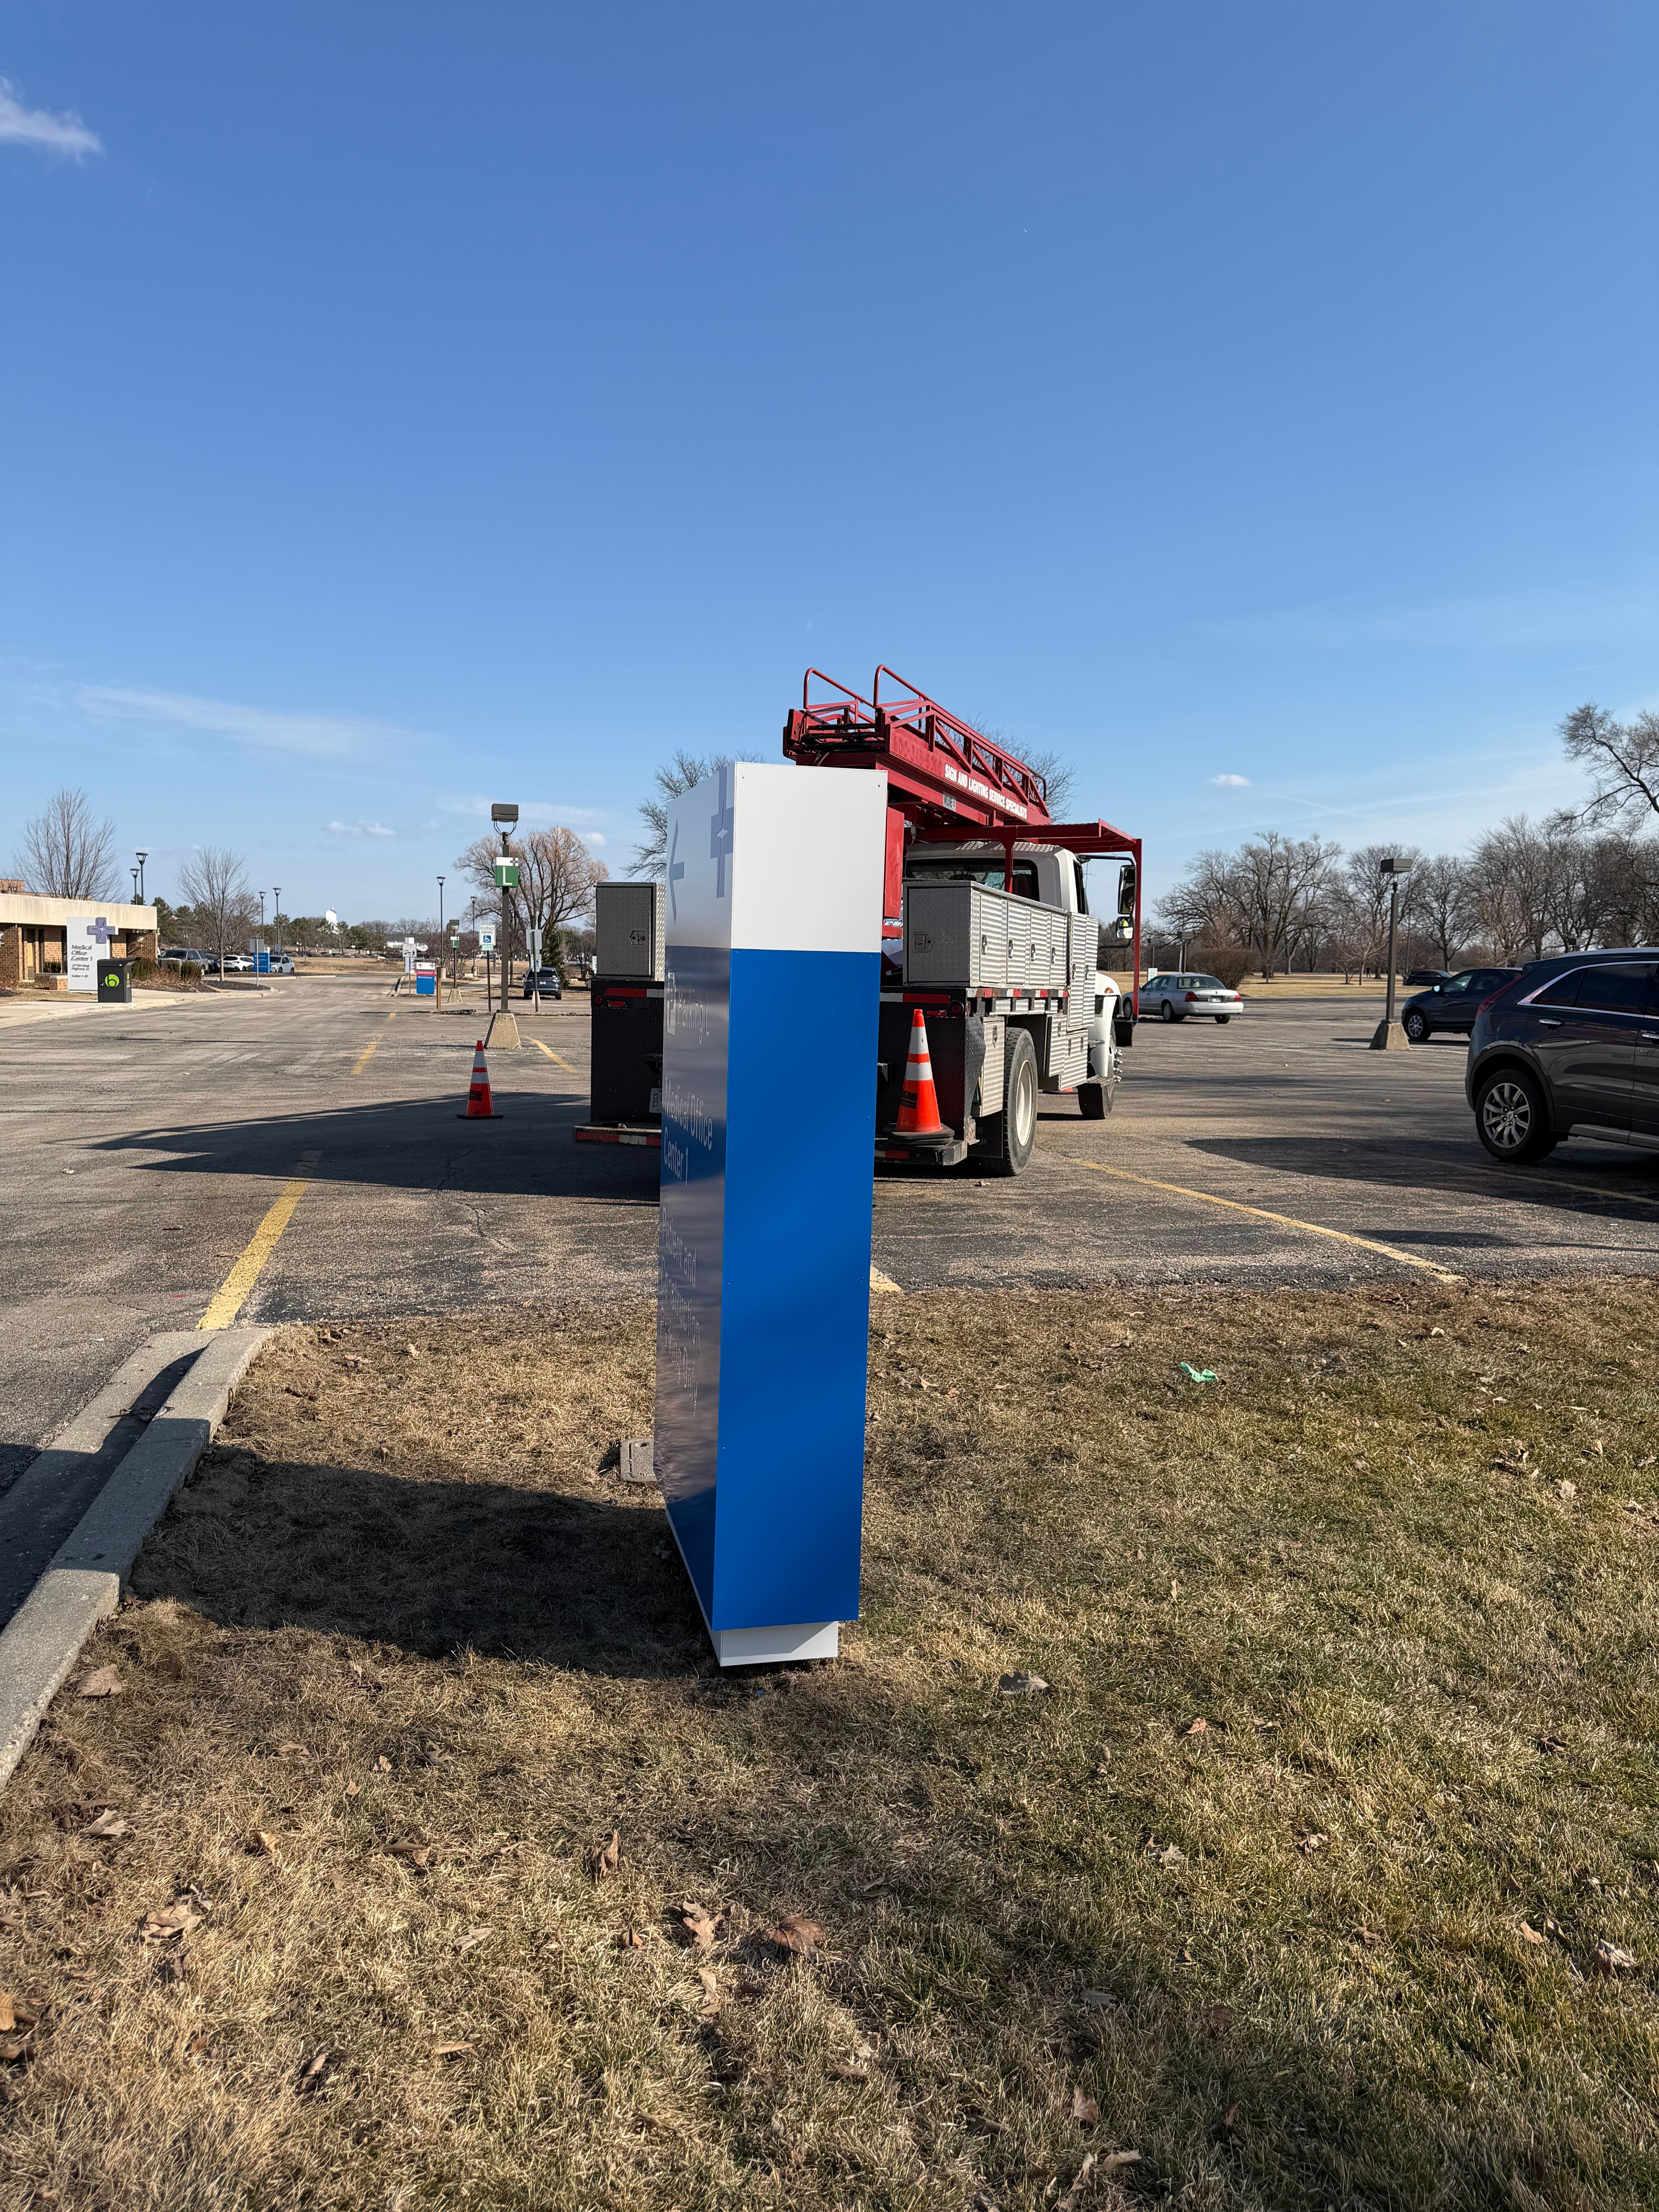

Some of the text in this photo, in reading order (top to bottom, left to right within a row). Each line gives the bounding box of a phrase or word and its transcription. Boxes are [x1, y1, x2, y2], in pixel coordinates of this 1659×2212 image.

[945, 764, 1028, 819] SIGN AND LIGHTING SERVICE SPECIALISTS
[503, 866, 512, 886] L
[678, 987, 703, 1044] Parking
[706, 993, 709, 1036] L
[665, 1077, 712, 1150] Medical Office
[664, 1127, 688, 1186] Center 1
[662, 1205, 696, 1288] Patient and
[661, 1255, 700, 1354] Construction
